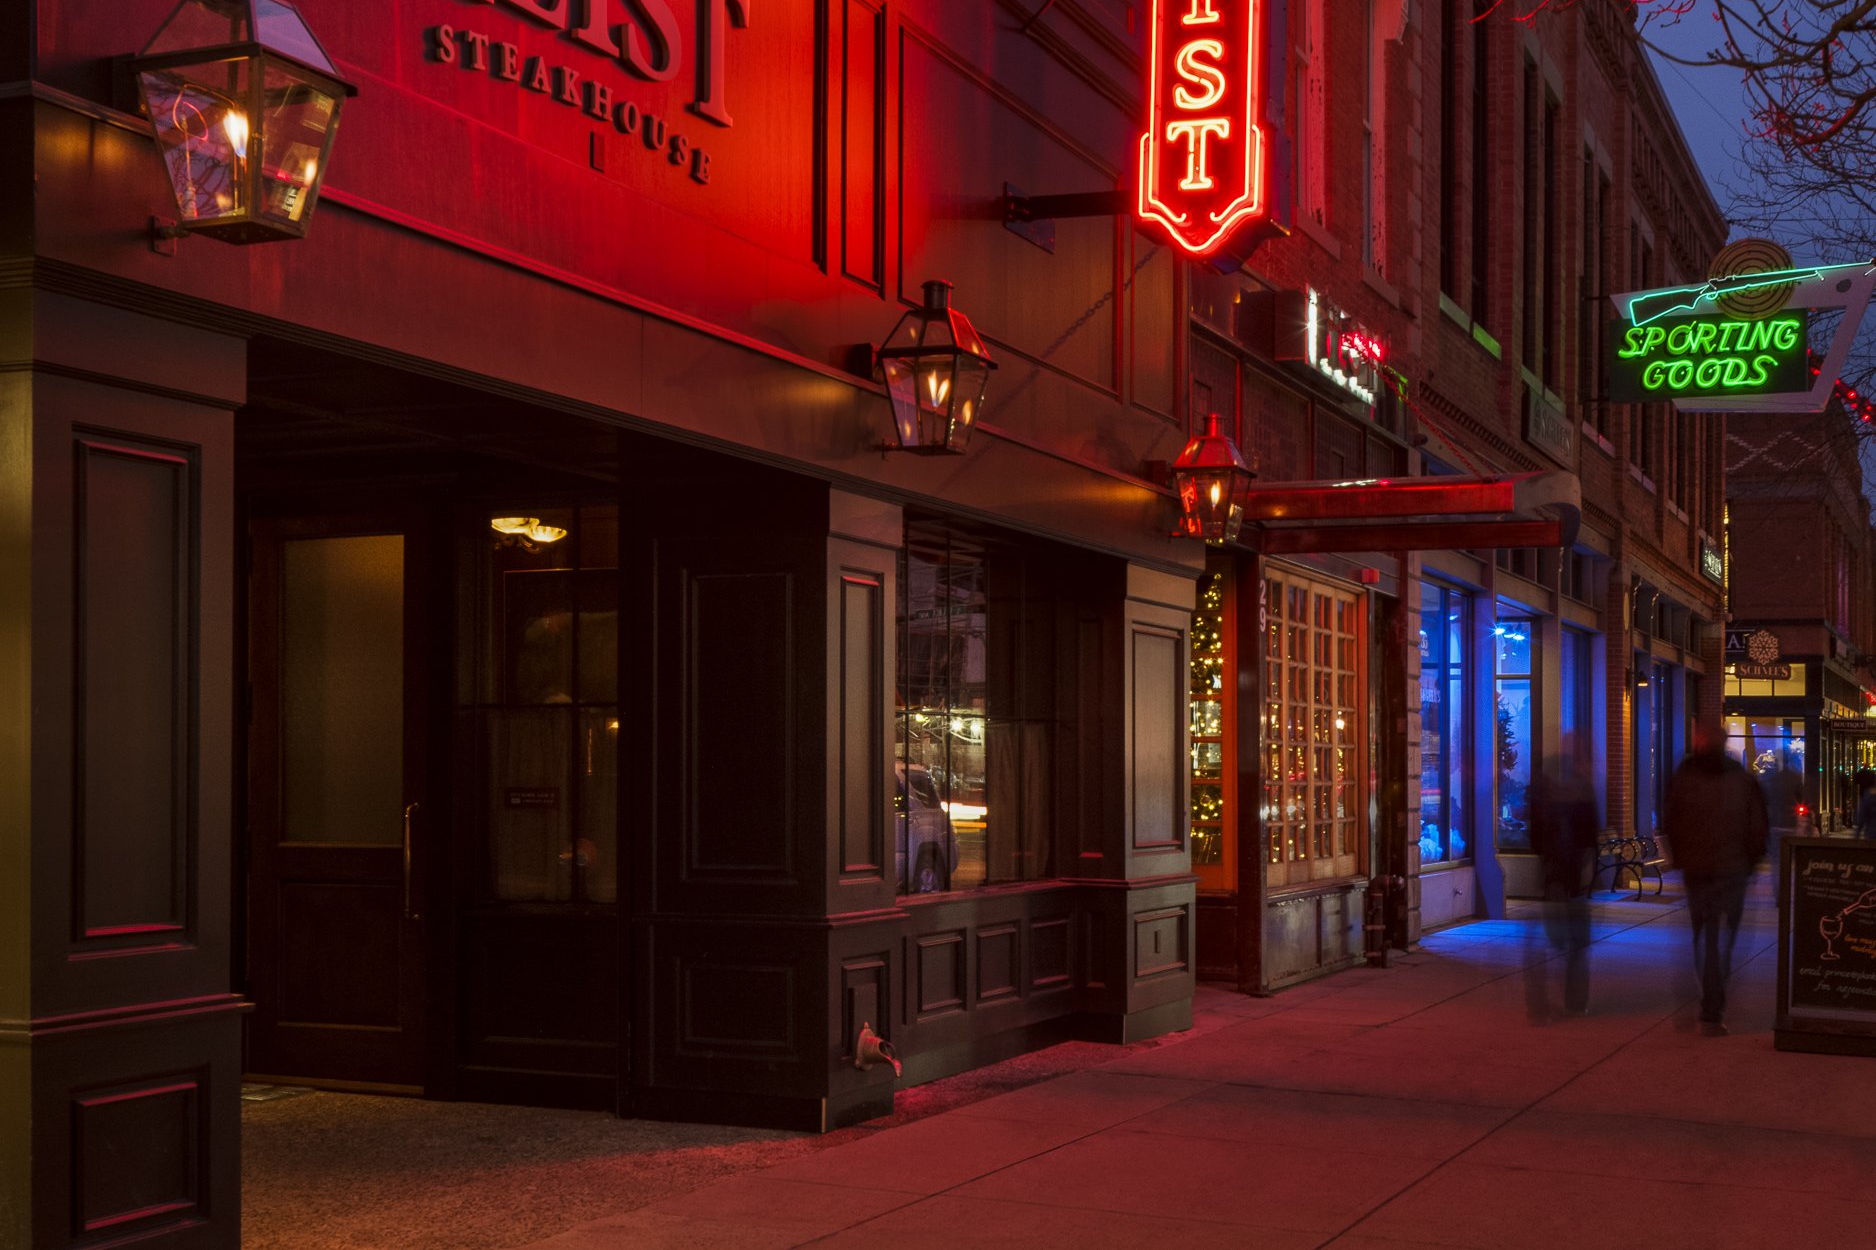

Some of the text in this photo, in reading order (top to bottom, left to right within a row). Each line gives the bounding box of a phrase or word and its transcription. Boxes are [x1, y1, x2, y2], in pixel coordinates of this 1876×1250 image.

[434, 24, 712, 185] STEAKHOUSE
[1617, 320, 1800, 359] SPORTING
[1642, 355, 1779, 390] GOODS
